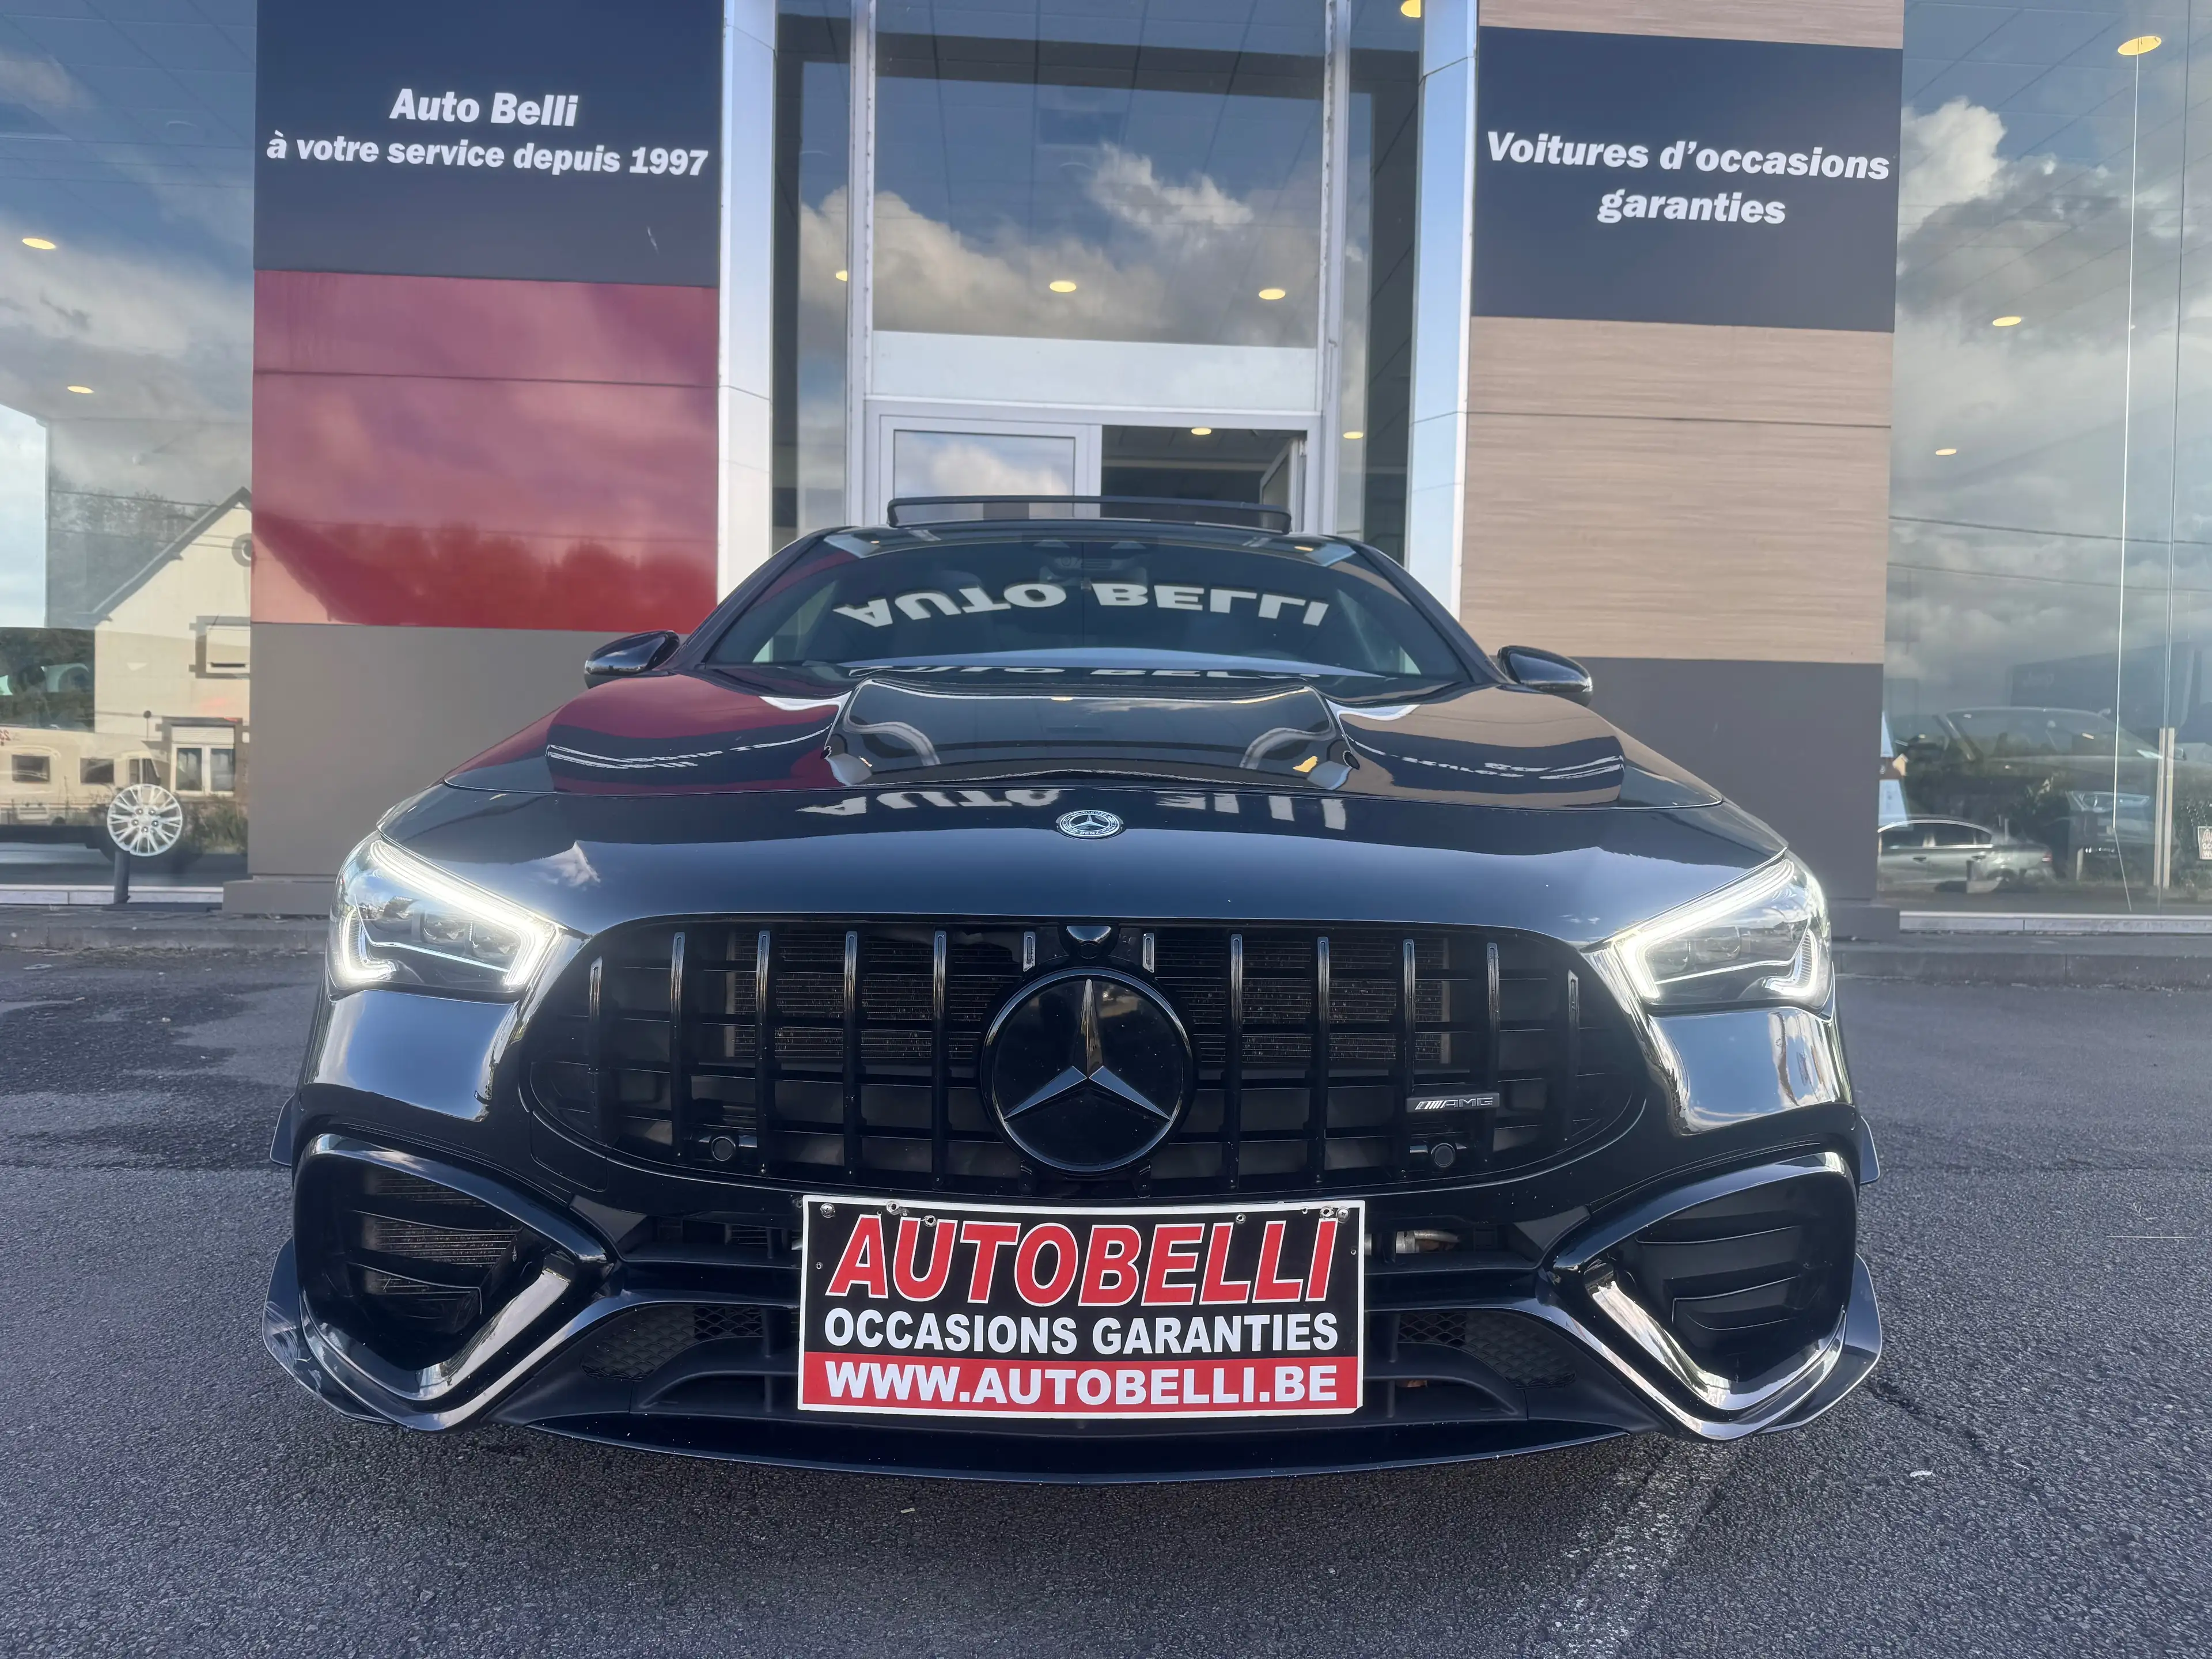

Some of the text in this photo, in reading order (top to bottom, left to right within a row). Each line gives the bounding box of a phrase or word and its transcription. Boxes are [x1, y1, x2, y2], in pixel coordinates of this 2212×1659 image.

[389, 88, 578, 126] Auto Belli
[266, 130, 709, 176] à votre service depuis 1997
[1487, 131, 1649, 168] Voitures
[1597, 188, 1786, 224] garanties
[825, 1213, 1338, 1306] AUTOBELLI
[824, 1308, 1338, 1355] OCCASIONS GARANTIES
[824, 1361, 1337, 1405] WWW.AUTOBELLI.BE
